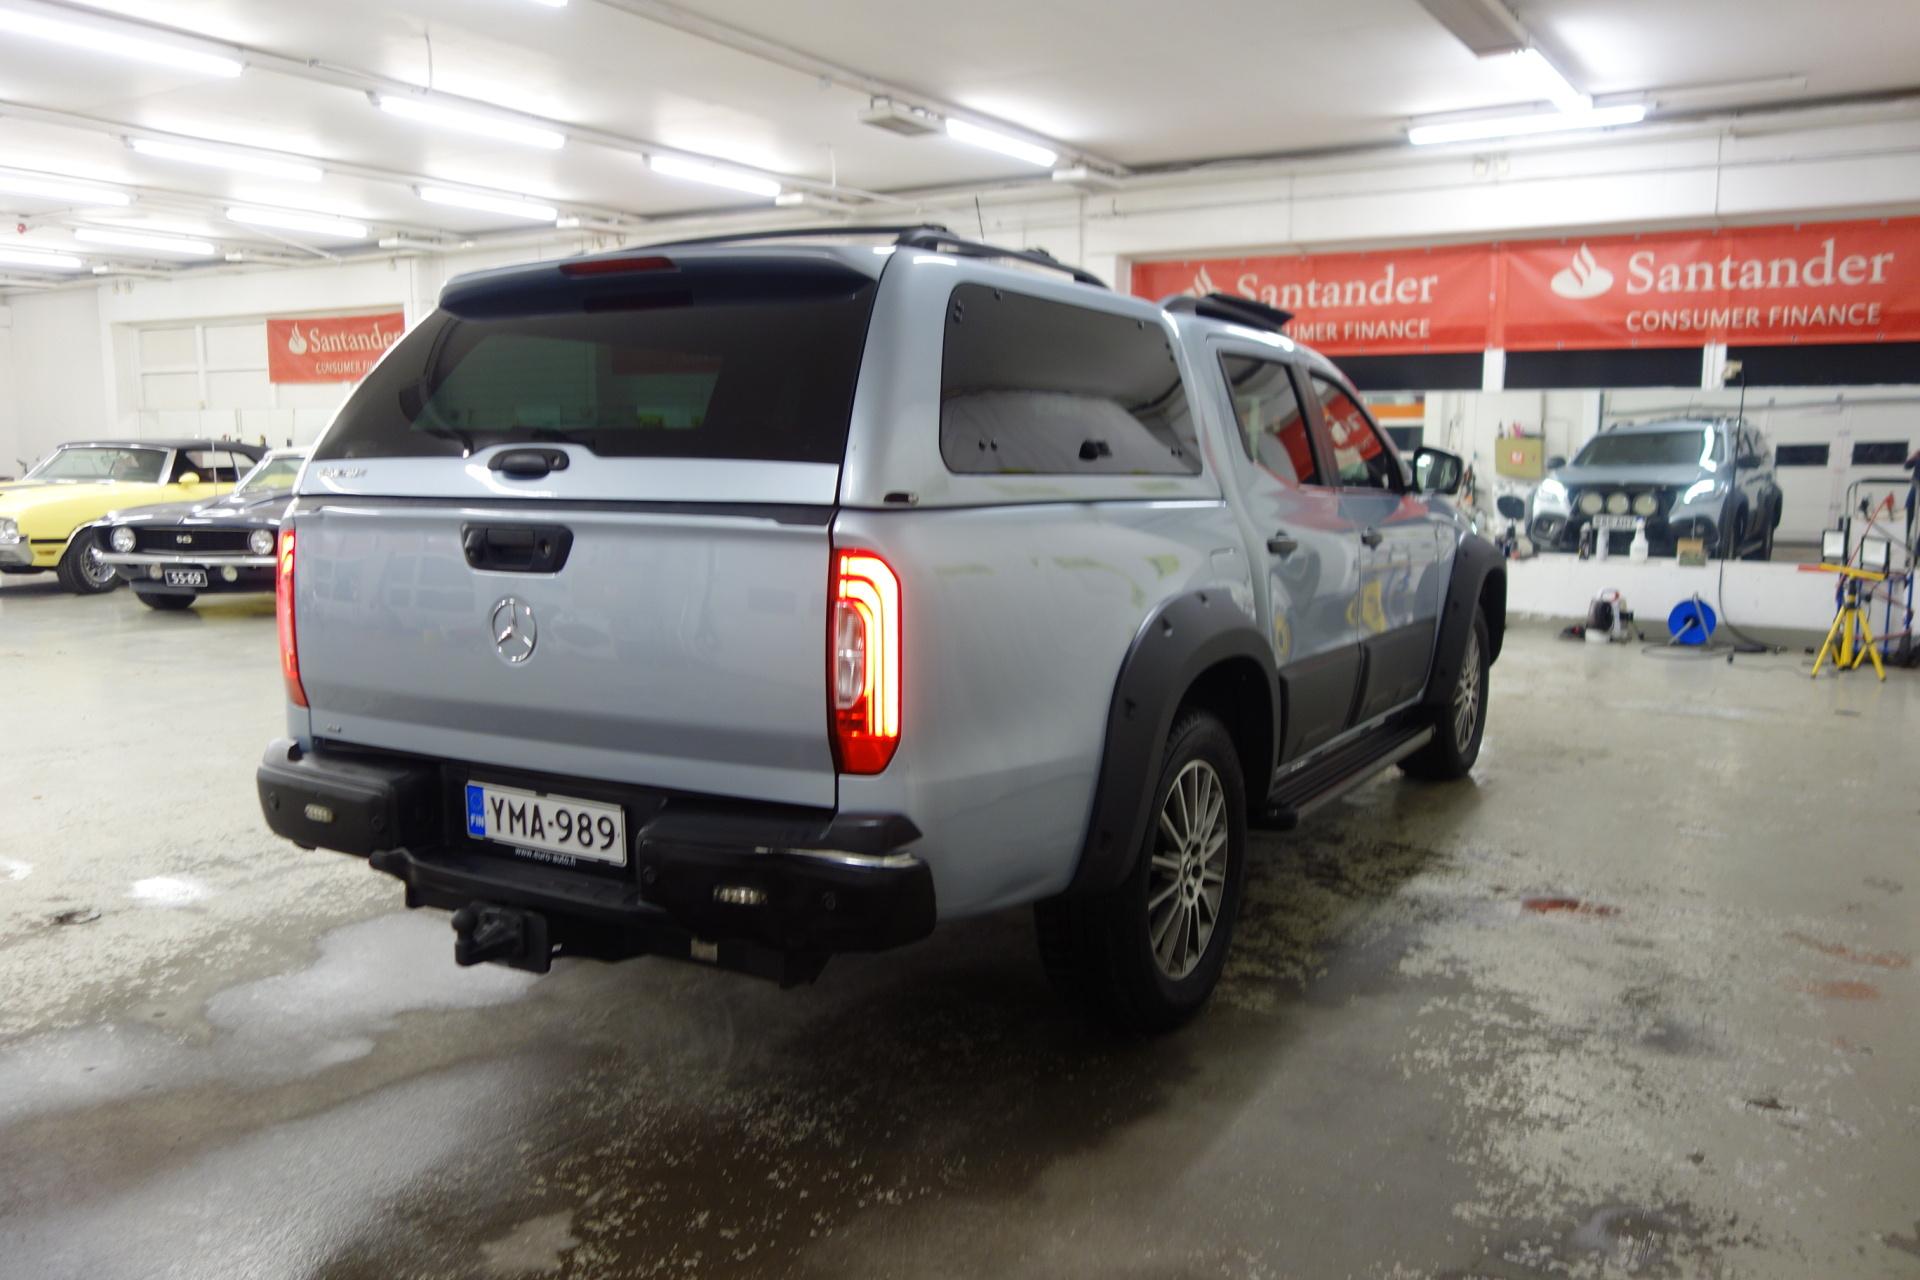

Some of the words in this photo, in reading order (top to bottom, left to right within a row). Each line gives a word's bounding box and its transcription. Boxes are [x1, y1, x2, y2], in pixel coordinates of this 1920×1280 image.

[1625, 237, 1895, 296] Santander
[1235, 262, 1438, 311] Santander
[1343, 317, 1431, 341] FINANCE
[1625, 305, 1760, 332] CONSUMER
[1768, 302, 1882, 328] FINANCE
[309, 322, 402, 354] Santander
[315, 360, 361, 376] CONSUMER
[470, 812, 486, 828] FIN
[489, 796, 616, 852] YMA-989
